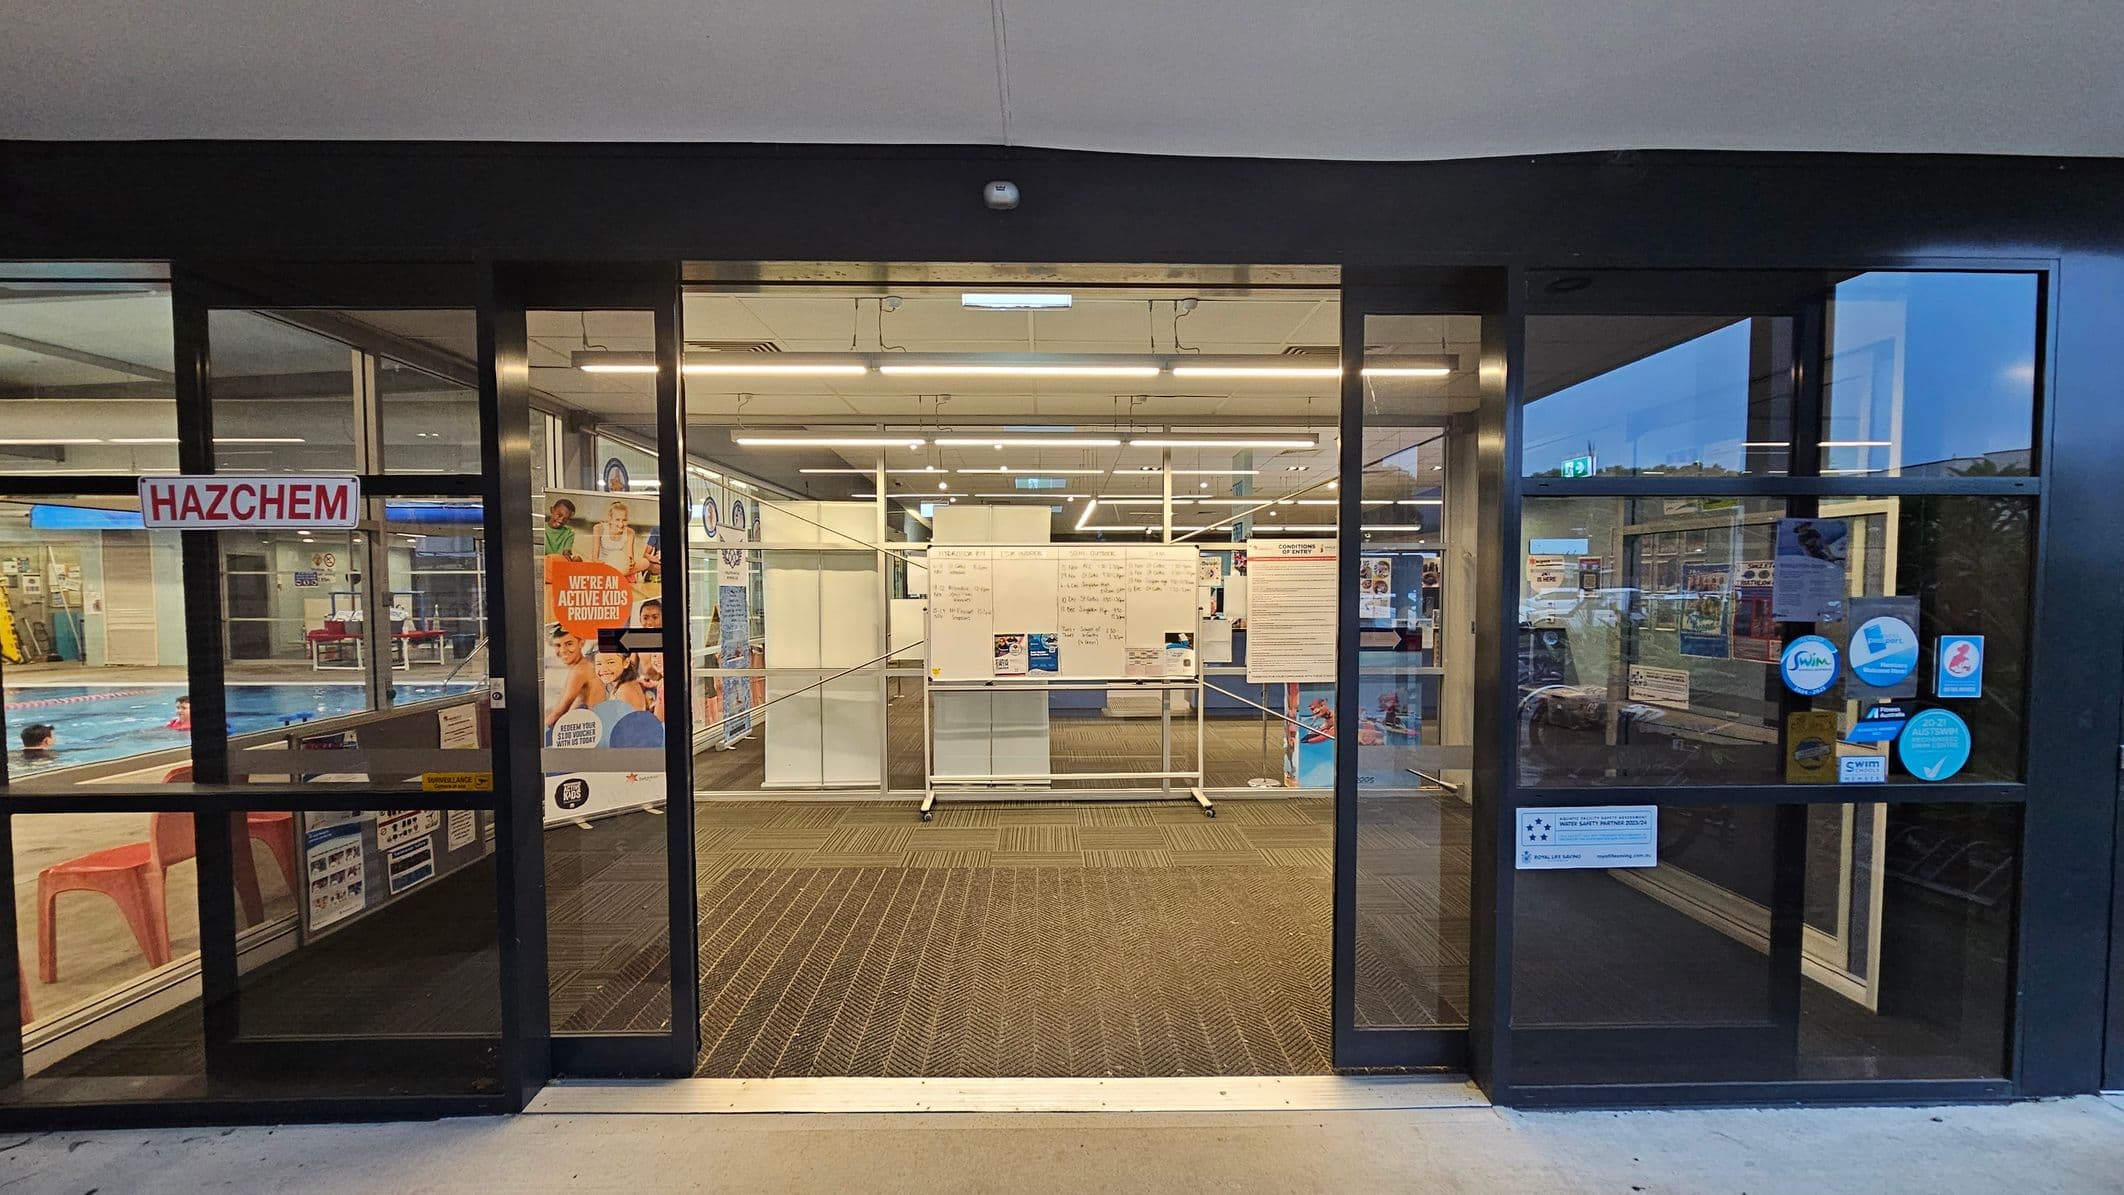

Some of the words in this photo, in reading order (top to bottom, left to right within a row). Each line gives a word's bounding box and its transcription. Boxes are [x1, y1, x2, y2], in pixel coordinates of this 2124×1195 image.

[151, 483, 348, 521] HAZCHEM
[568, 576, 603, 589] WE'RE
[605, 576, 619, 589] AN
[558, 590, 600, 606] ACTIVE
[602, 590, 628, 606] KIDS
[568, 606, 620, 621] PROVIDER!
[1788, 650, 1832, 671] Swim
[560, 723, 581, 731] REDEEM
[582, 721, 596, 729] YOUR
[573, 729, 596, 738] VOUCHER
[1912, 727, 1959, 736] AUSTSWIM
[557, 739, 570, 747] WITH
[427, 776, 473, 784] SURVEILLANCE
[563, 783, 582, 791] ACTIVE
[563, 790, 582, 801] KIDS
